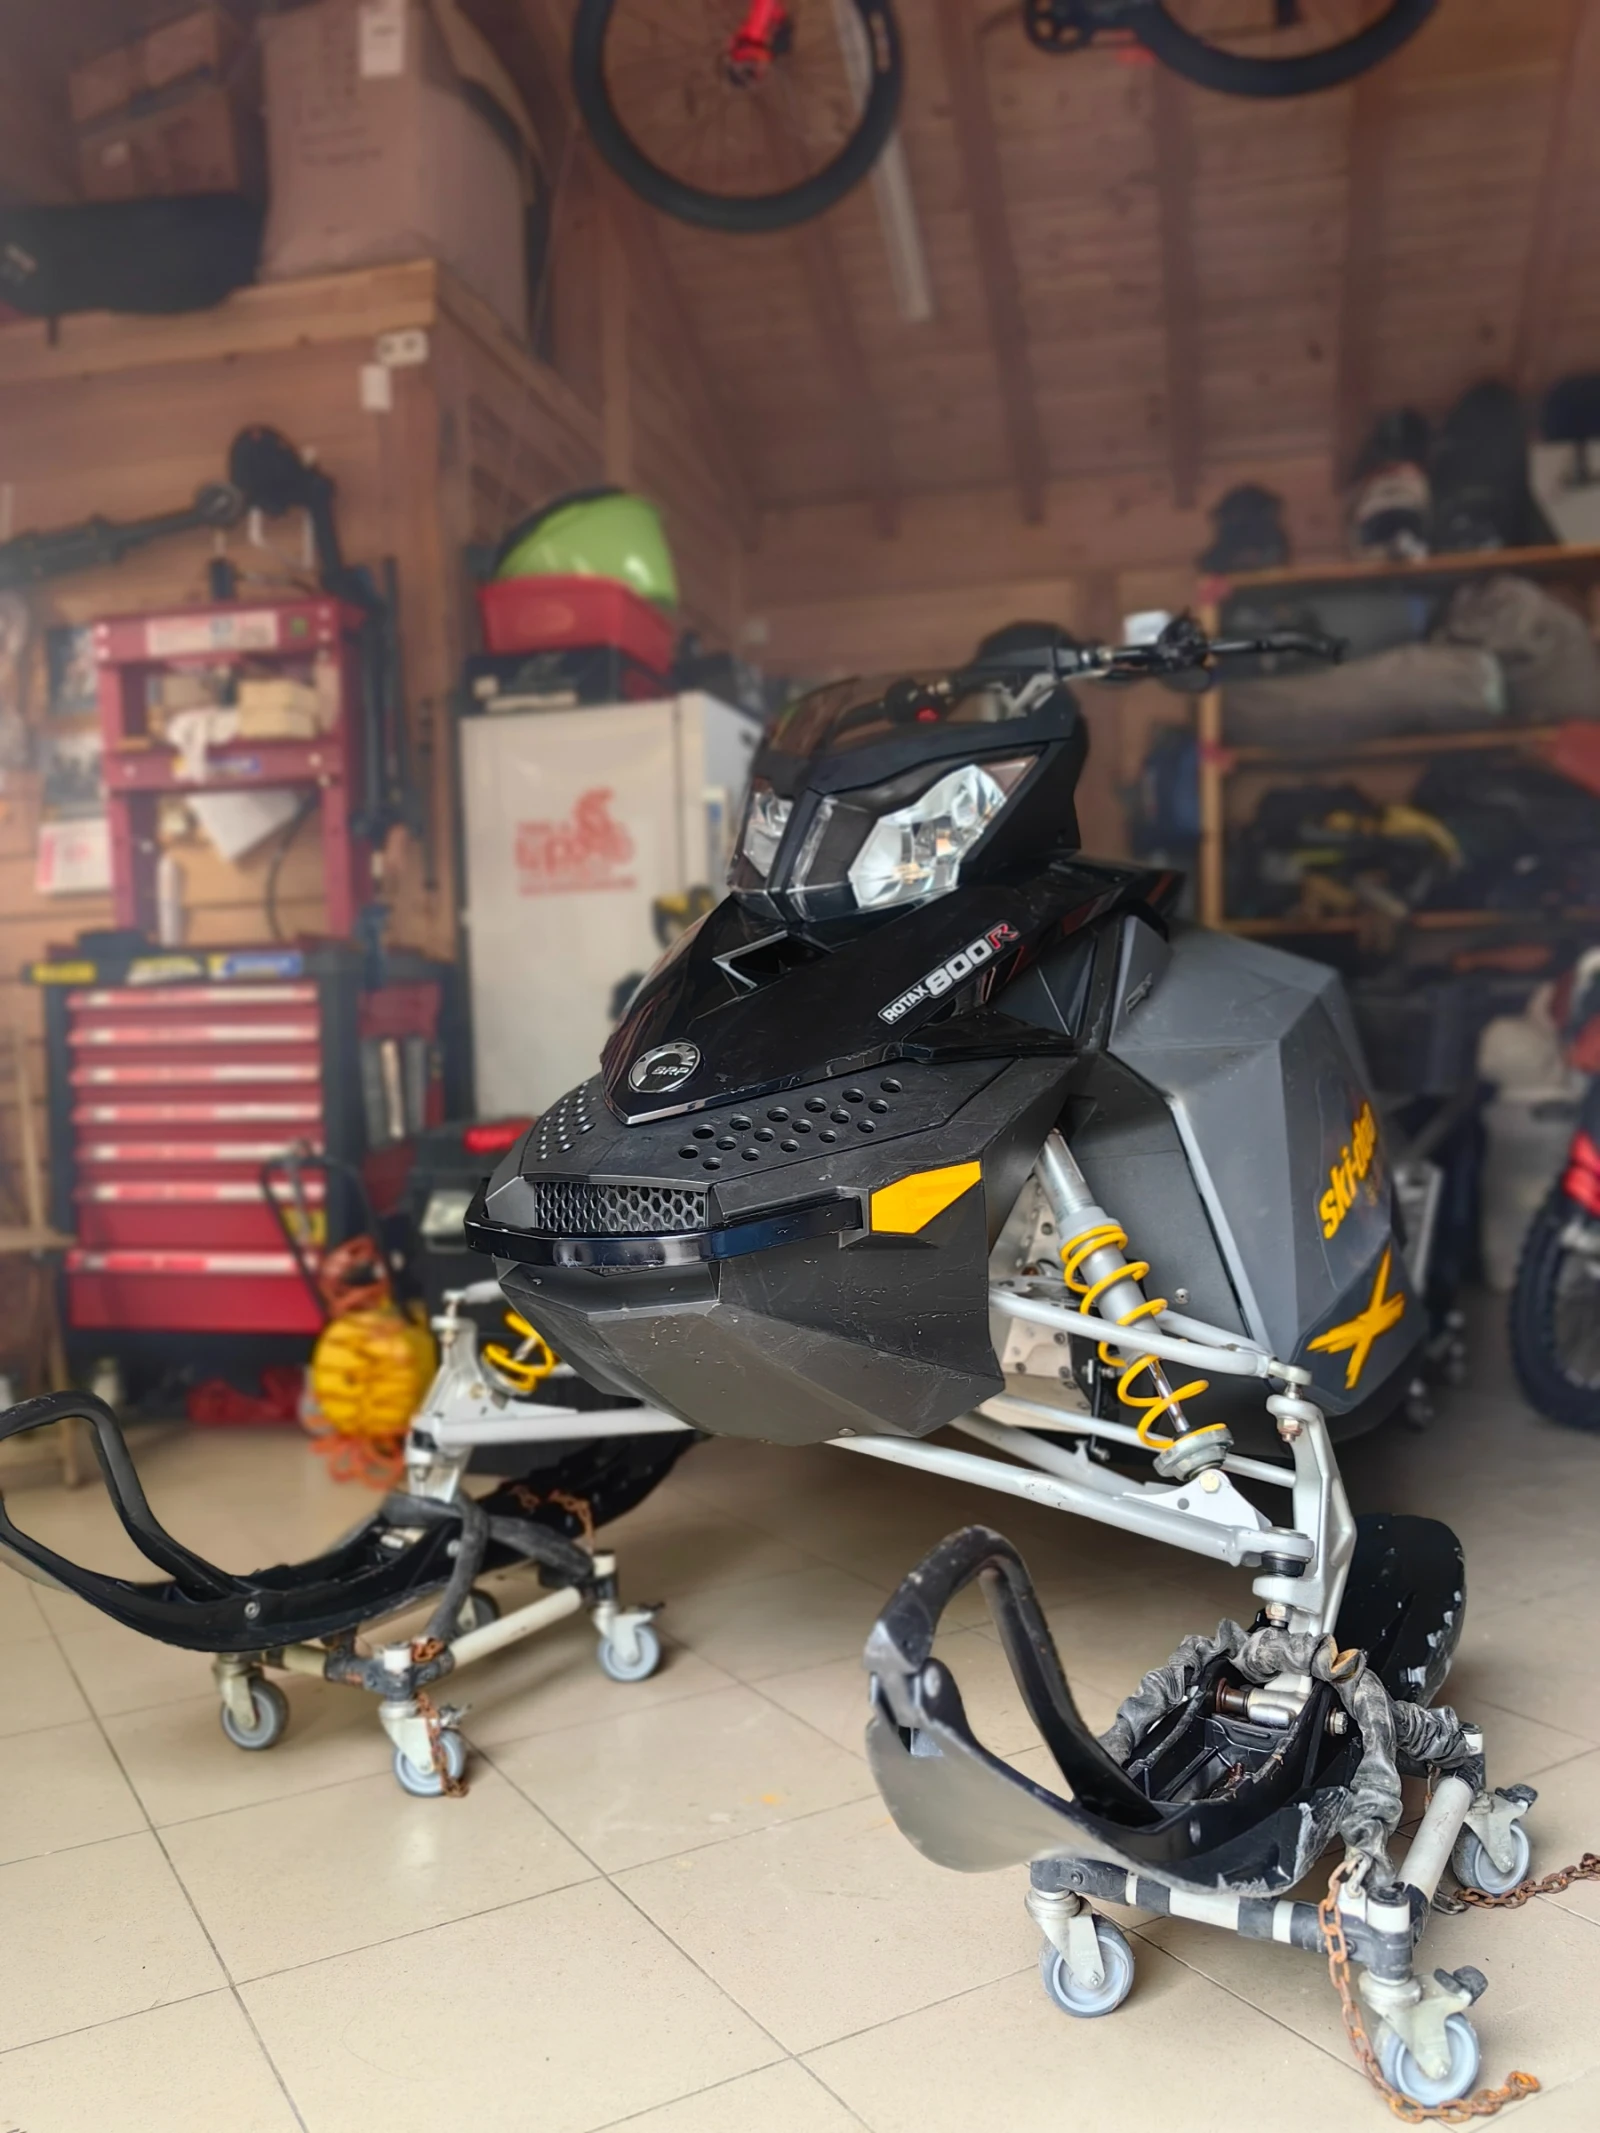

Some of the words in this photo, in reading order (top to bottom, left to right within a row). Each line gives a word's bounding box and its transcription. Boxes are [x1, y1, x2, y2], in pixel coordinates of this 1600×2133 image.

[882, 984, 929, 1021] ROTAX
[925, 923, 1019, 996] 800R
[651, 1065, 690, 1076] BRP
